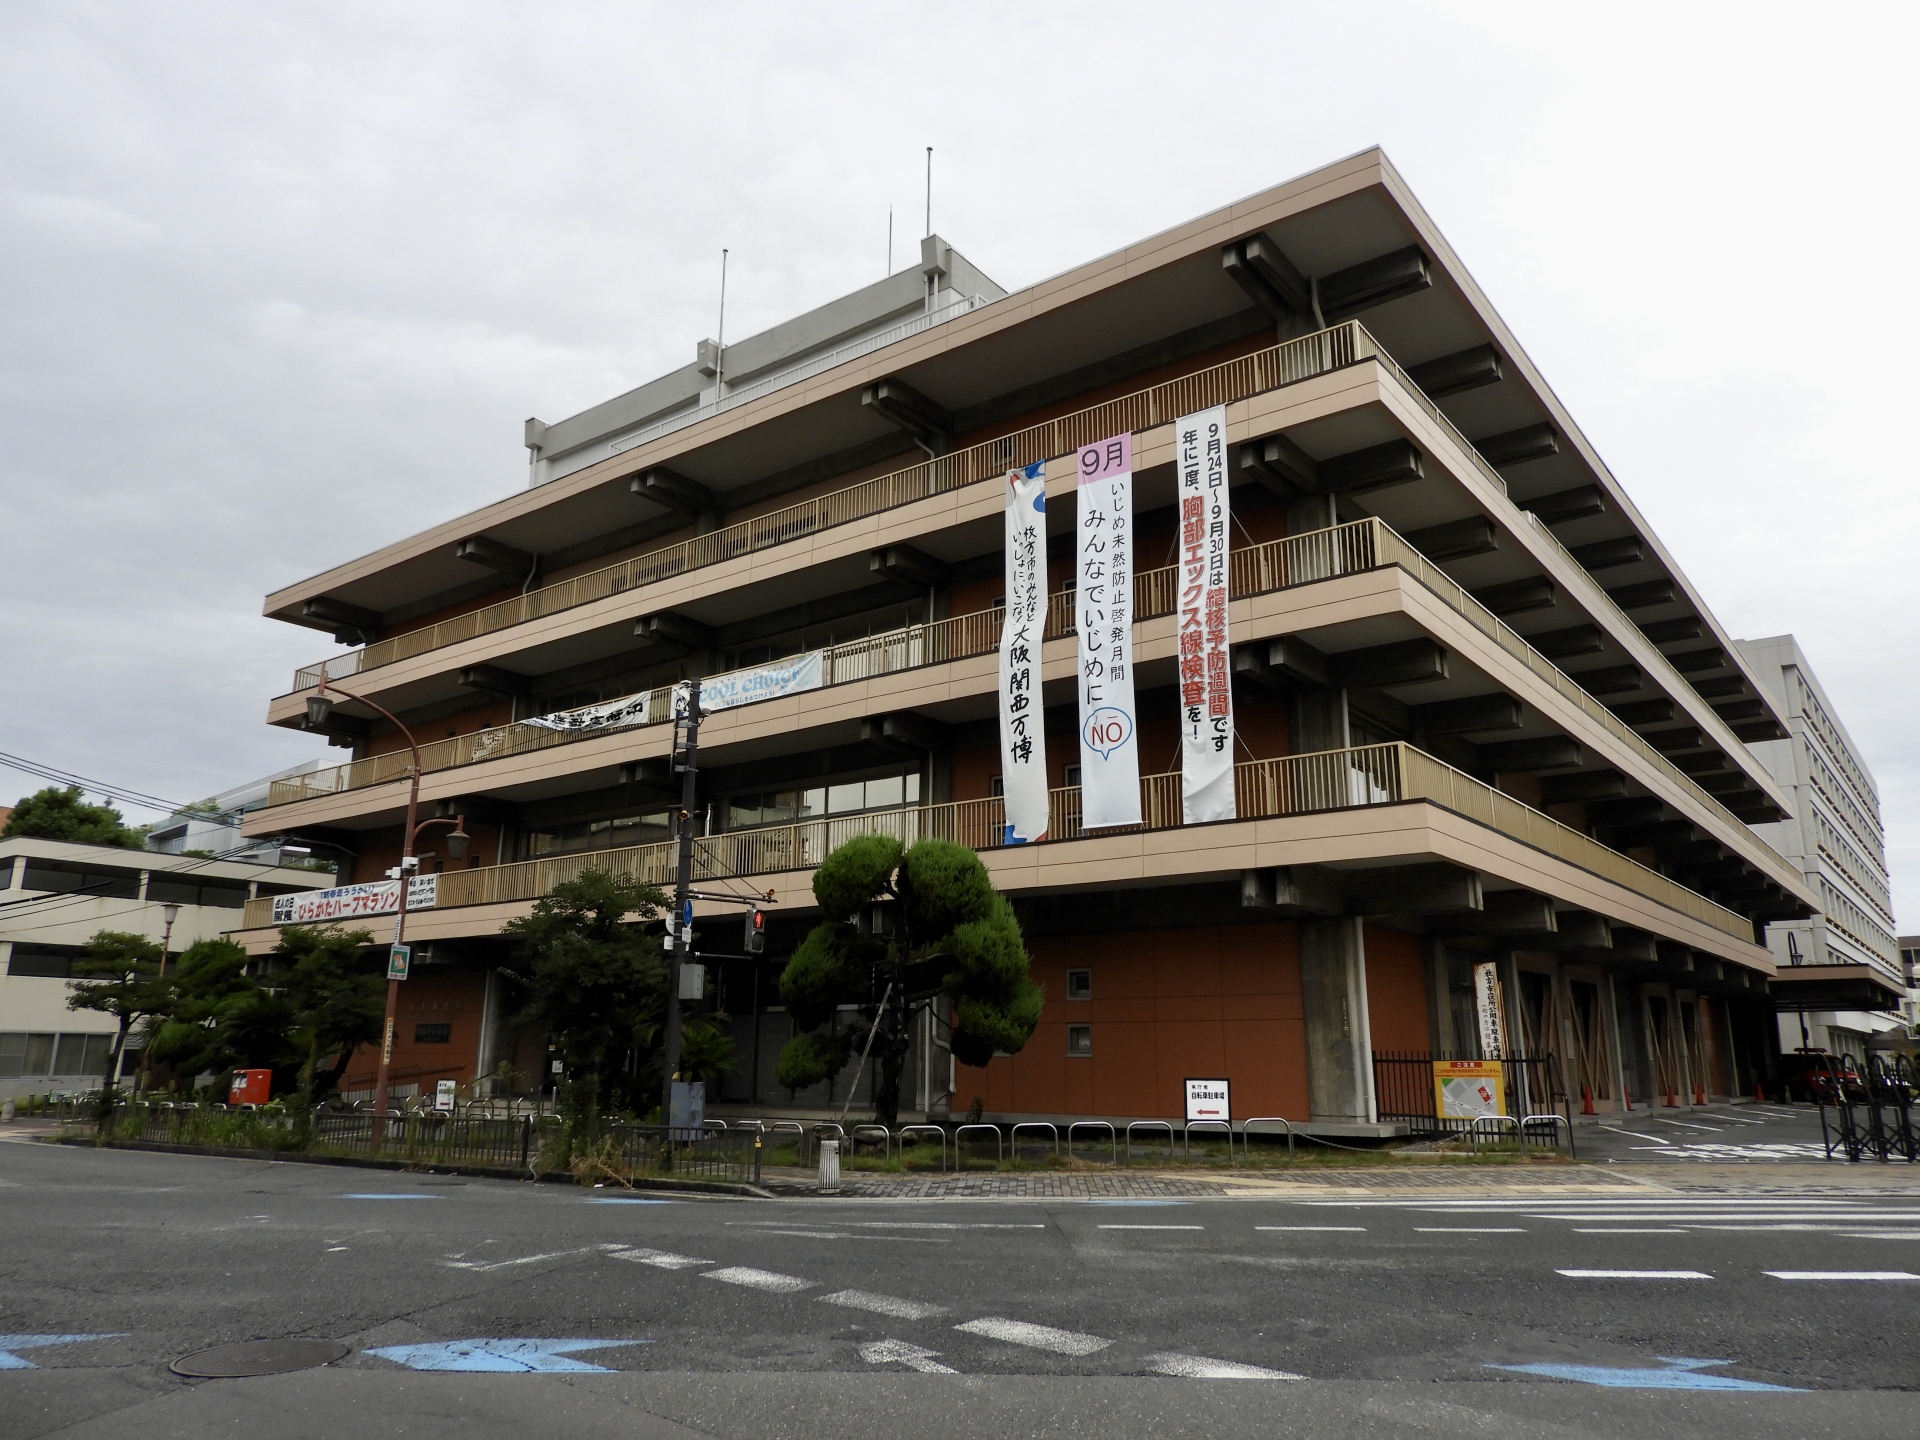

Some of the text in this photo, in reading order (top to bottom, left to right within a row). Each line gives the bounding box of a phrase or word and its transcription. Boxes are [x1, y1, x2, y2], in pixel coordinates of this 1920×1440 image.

[1081, 441, 1123, 476] 9月
[1024, 525, 1038, 622] 枚方市のみんなと
[1110, 483, 1126, 683] いじめ未然防止啓発月間
[1084, 509, 1106, 705] みんなでいじめに
[699, 665, 801, 703] COOL CHOICE
[1092, 722, 1123, 746] NO
[273, 909, 293, 922] 開催
[1191, 1091, 1225, 1100] 自転車駐車場
